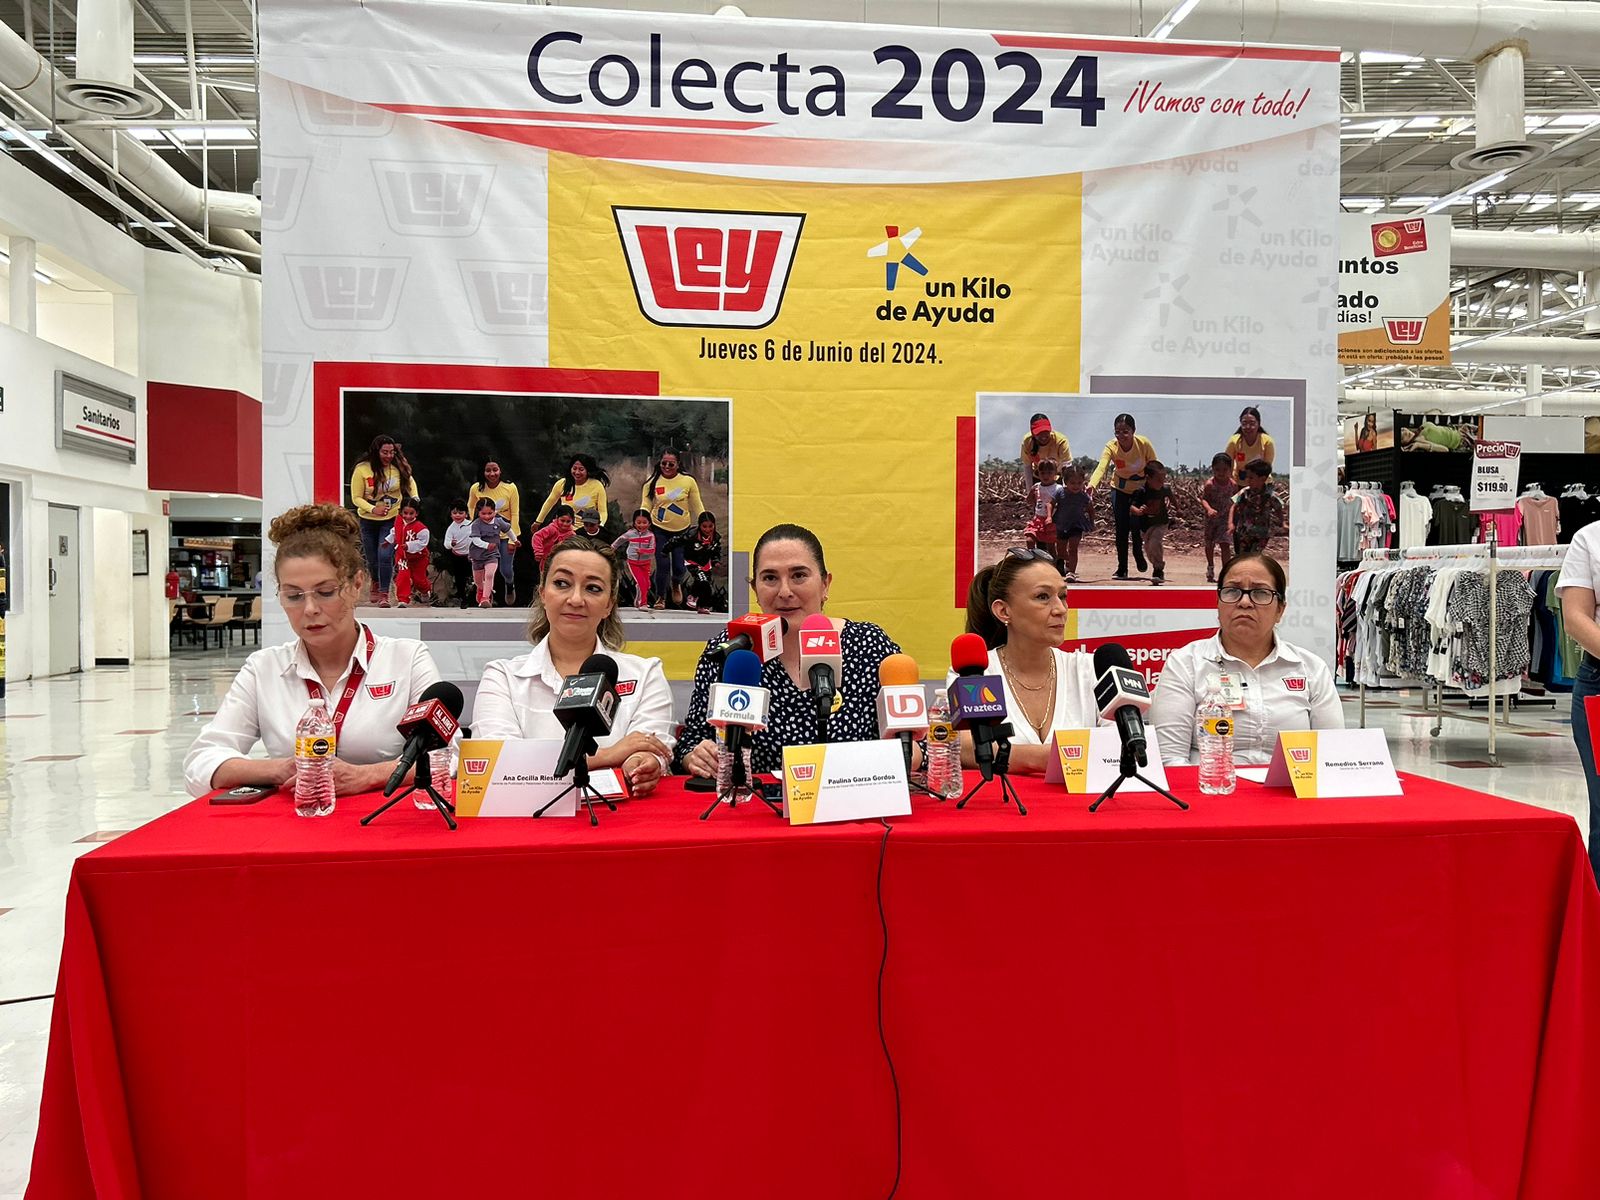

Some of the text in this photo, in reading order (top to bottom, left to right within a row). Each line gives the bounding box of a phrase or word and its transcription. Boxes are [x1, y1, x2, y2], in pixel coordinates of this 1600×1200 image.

[526, 30, 1106, 127] Colecta 2024
[1123, 80, 1311, 119] ¡Vamos con todo!
[1290, 229, 1333, 247] Kilo
[1219, 248, 1318, 270] de Ayuda
[925, 276, 1011, 299] un Kilo
[876, 300, 994, 327] de Ayuda
[1223, 316, 1264, 334] Kilo
[699, 337, 943, 364] Jueves 6 de Junio del 2024.
[1151, 337, 1250, 358] de Ayuda
[83, 406, 120, 430] Sanitarios
[1477, 443, 1504, 453] Precio
[1477, 466, 1499, 474] BLUSA
[720, 709, 755, 721] Fórmula
[963, 704, 1003, 713] tv azteca
[872, 774, 895, 782] Gordoa
